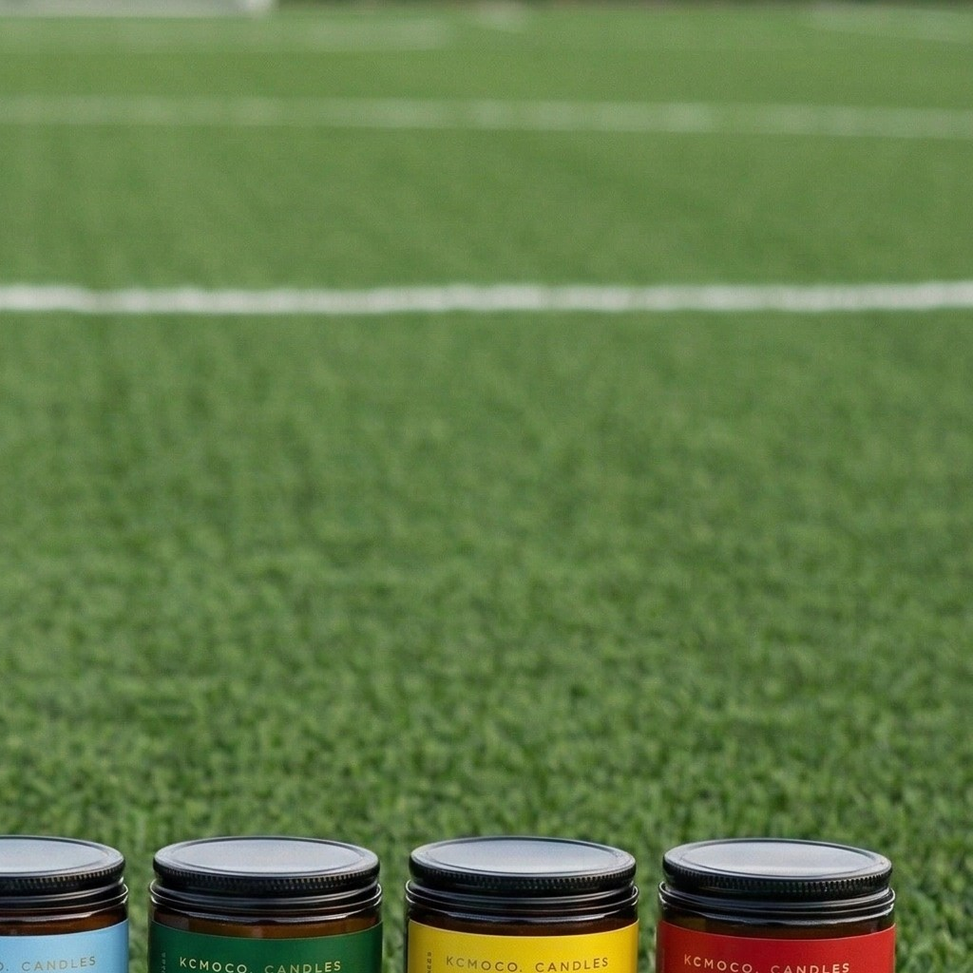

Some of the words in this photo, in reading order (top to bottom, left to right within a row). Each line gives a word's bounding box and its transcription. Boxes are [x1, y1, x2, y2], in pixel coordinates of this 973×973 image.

[22, 956, 96, 972] CANDLES
[446, 956, 522, 972] KCMOCO.
[535, 958, 608, 972] CANDLES
[684, 954, 759, 973] KCMOCO.
